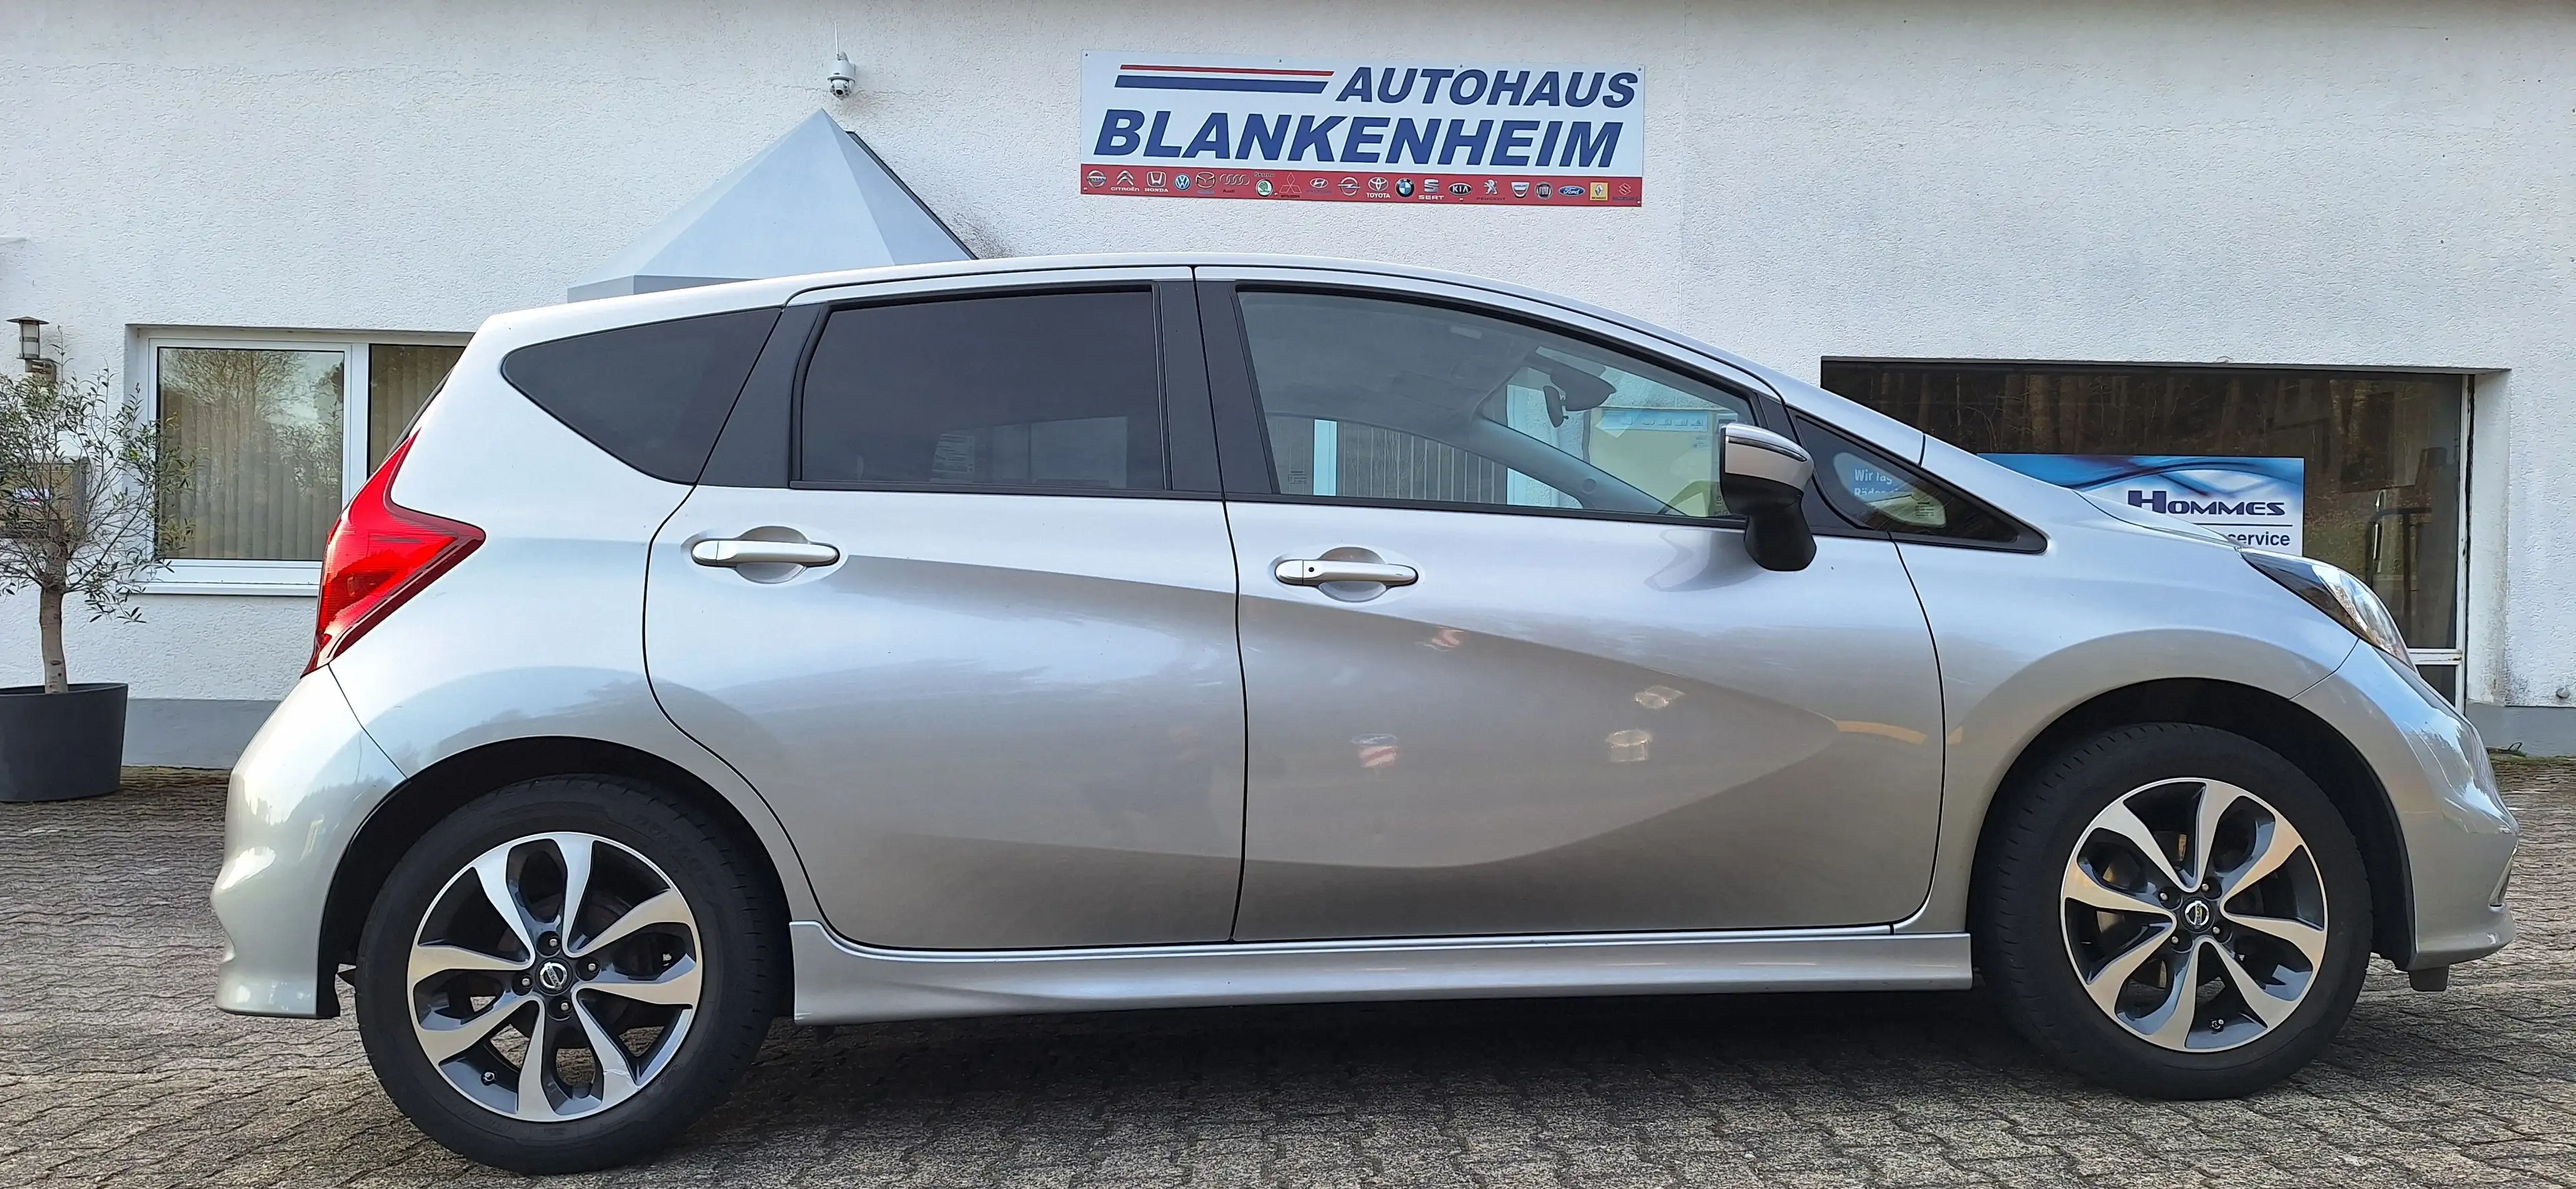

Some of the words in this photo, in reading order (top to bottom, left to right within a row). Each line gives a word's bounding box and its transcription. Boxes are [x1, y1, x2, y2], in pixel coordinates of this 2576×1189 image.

[1335, 66, 1638, 108] AUTOHAUS
[1093, 109, 1623, 168] BLANKENHEIM
[1539, 187, 1549, 195] FIAT
[1854, 468, 1874, 482] Wir
[2128, 490, 2286, 516] HOMMES
[546, 965, 560, 988] NISSAN
